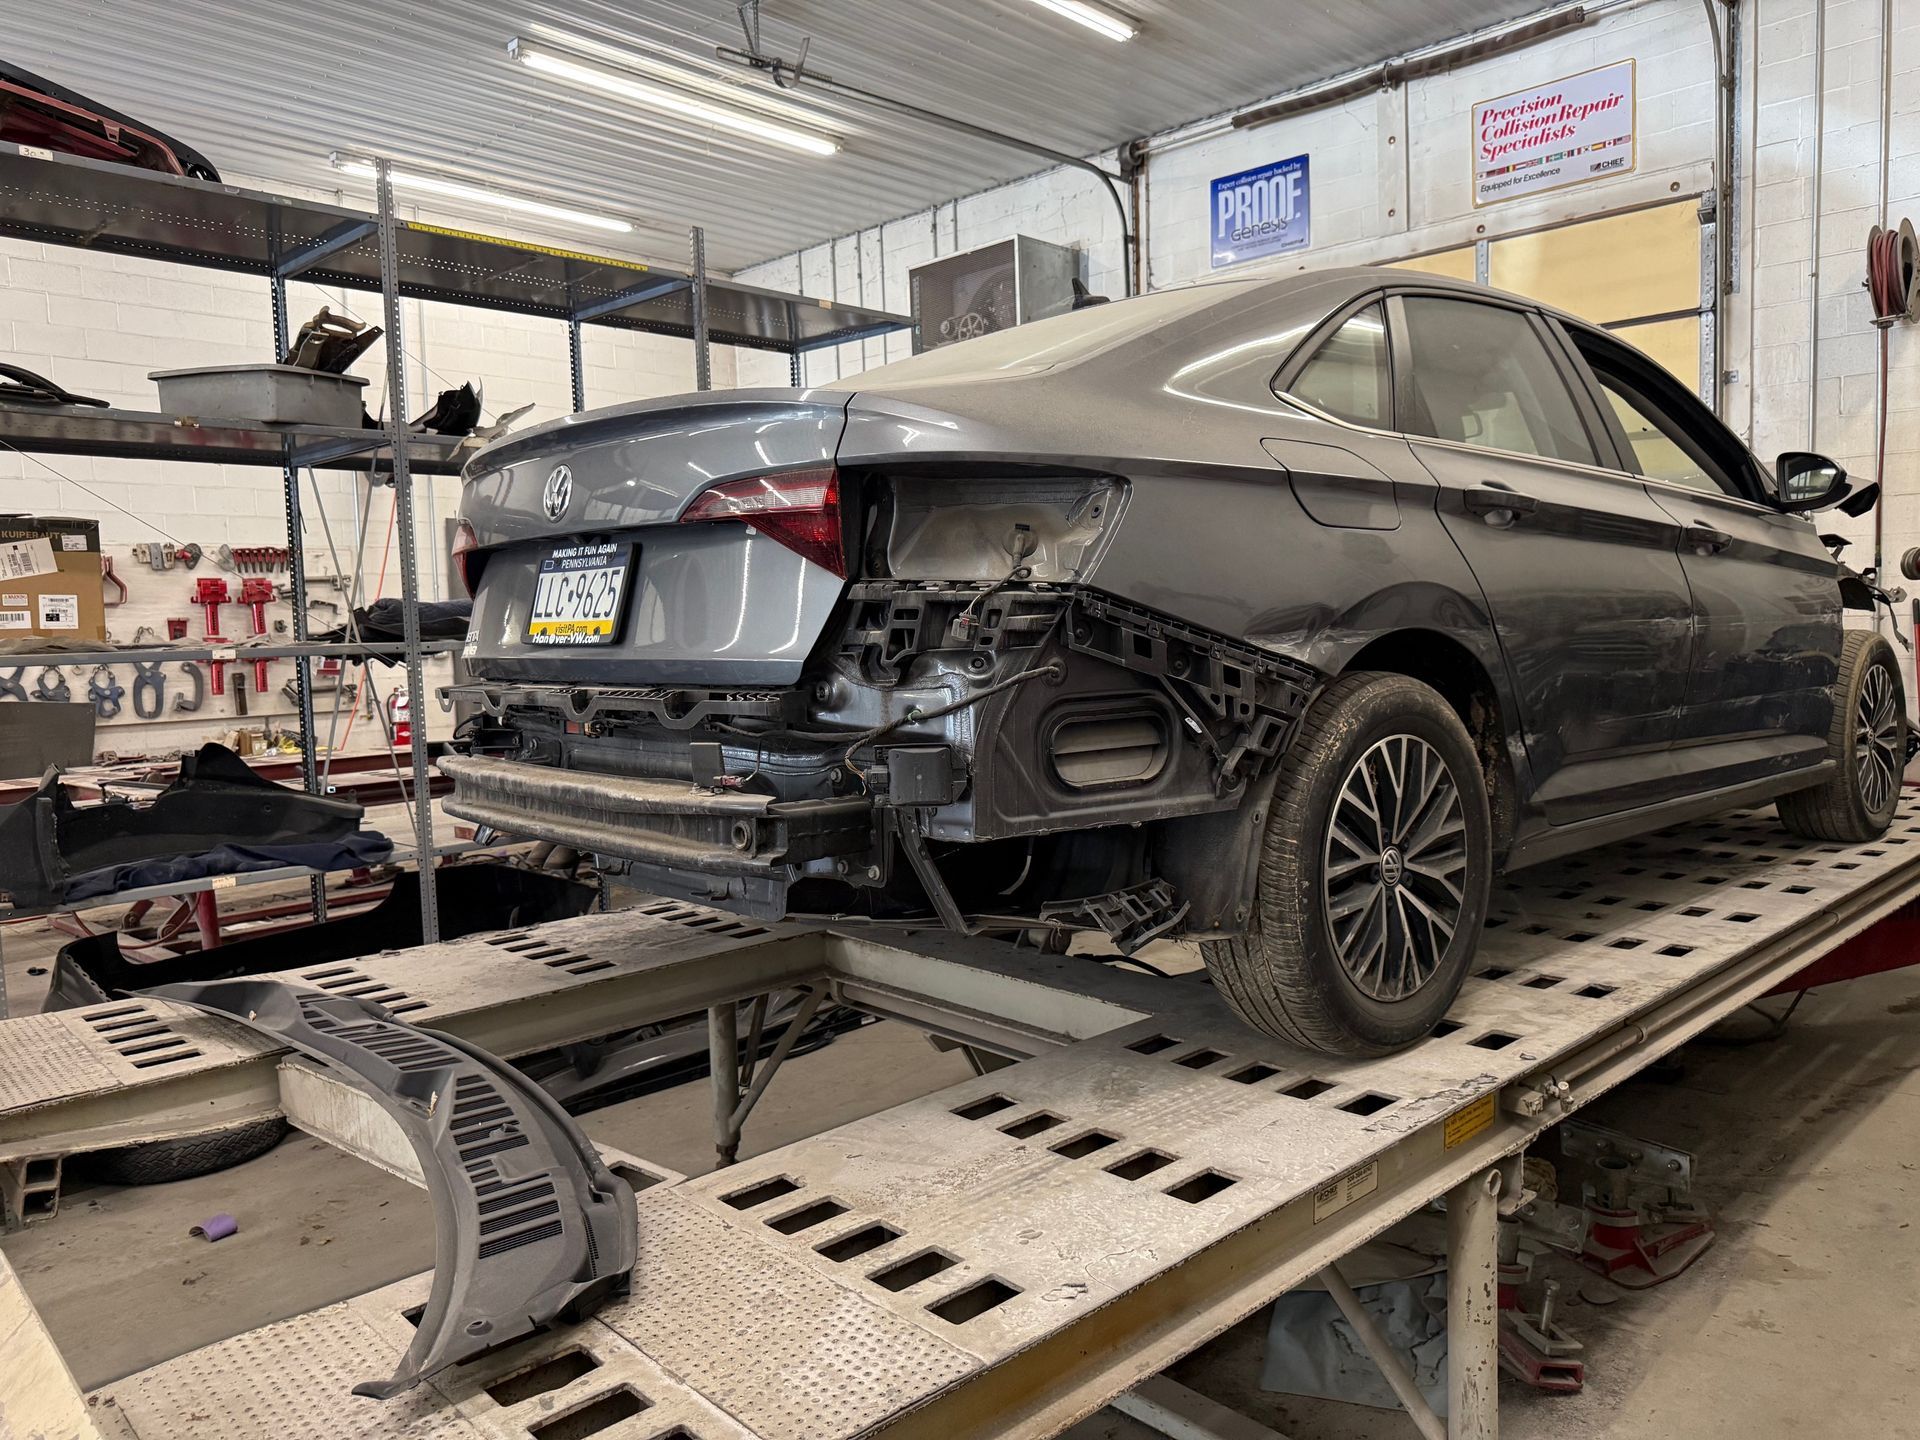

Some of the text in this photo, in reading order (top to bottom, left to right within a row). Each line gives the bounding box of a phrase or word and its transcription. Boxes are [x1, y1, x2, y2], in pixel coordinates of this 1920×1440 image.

[1480, 94, 1562, 126] Precision
[1481, 92, 1625, 143] Collision Repair
[1480, 124, 1576, 162] Specialists
[1601, 157, 1625, 169] CHIEF
[1480, 166, 1561, 193] Equipped for Excellence
[552, 543, 618, 558] MAKING IT FUN AGAIN
[561, 555, 607, 569] PENNSYLVANIA
